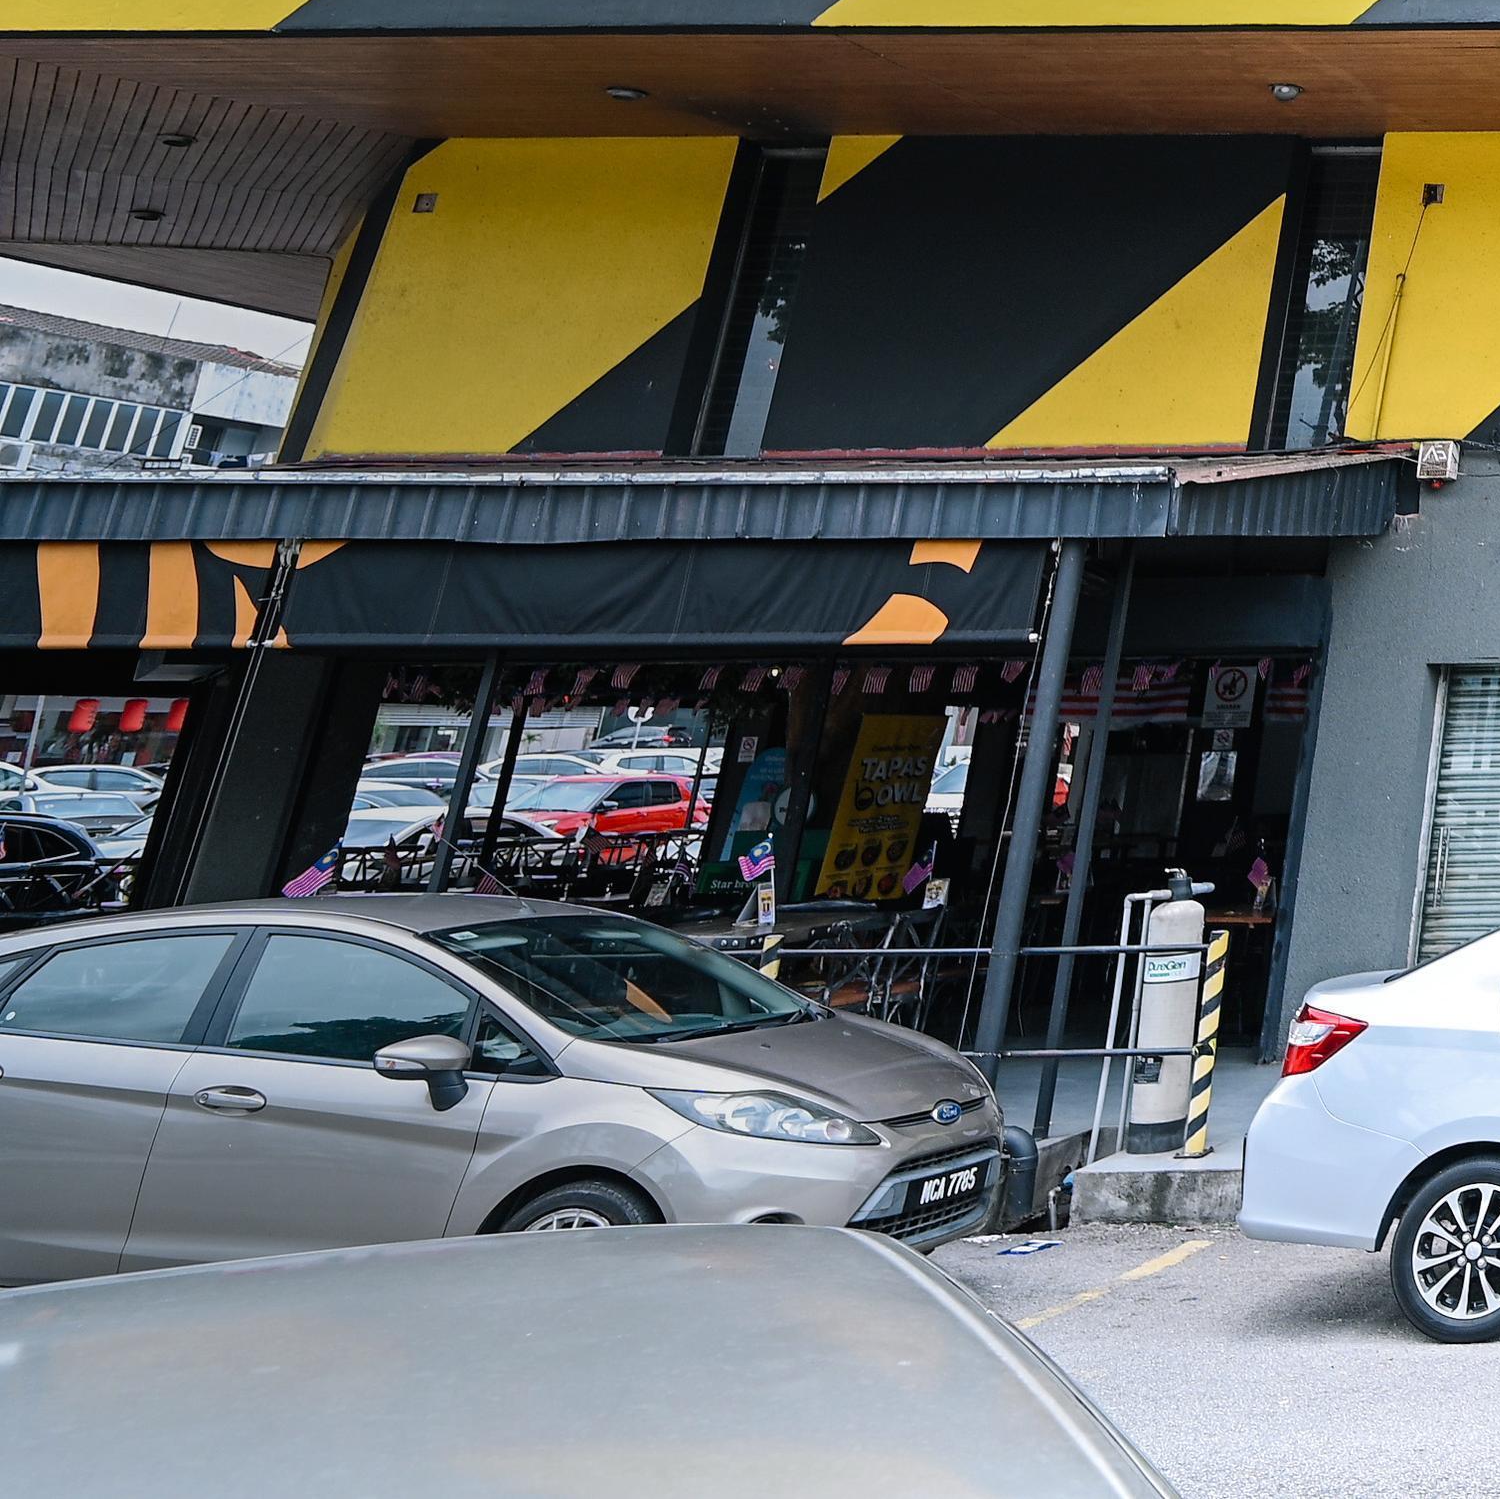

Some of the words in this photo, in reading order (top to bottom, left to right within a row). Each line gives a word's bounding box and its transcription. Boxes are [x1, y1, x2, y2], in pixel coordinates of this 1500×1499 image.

[862, 756, 929, 782] TAPAS
[711, 879, 731, 889] Star
[947, 1166, 979, 1198] 7785
